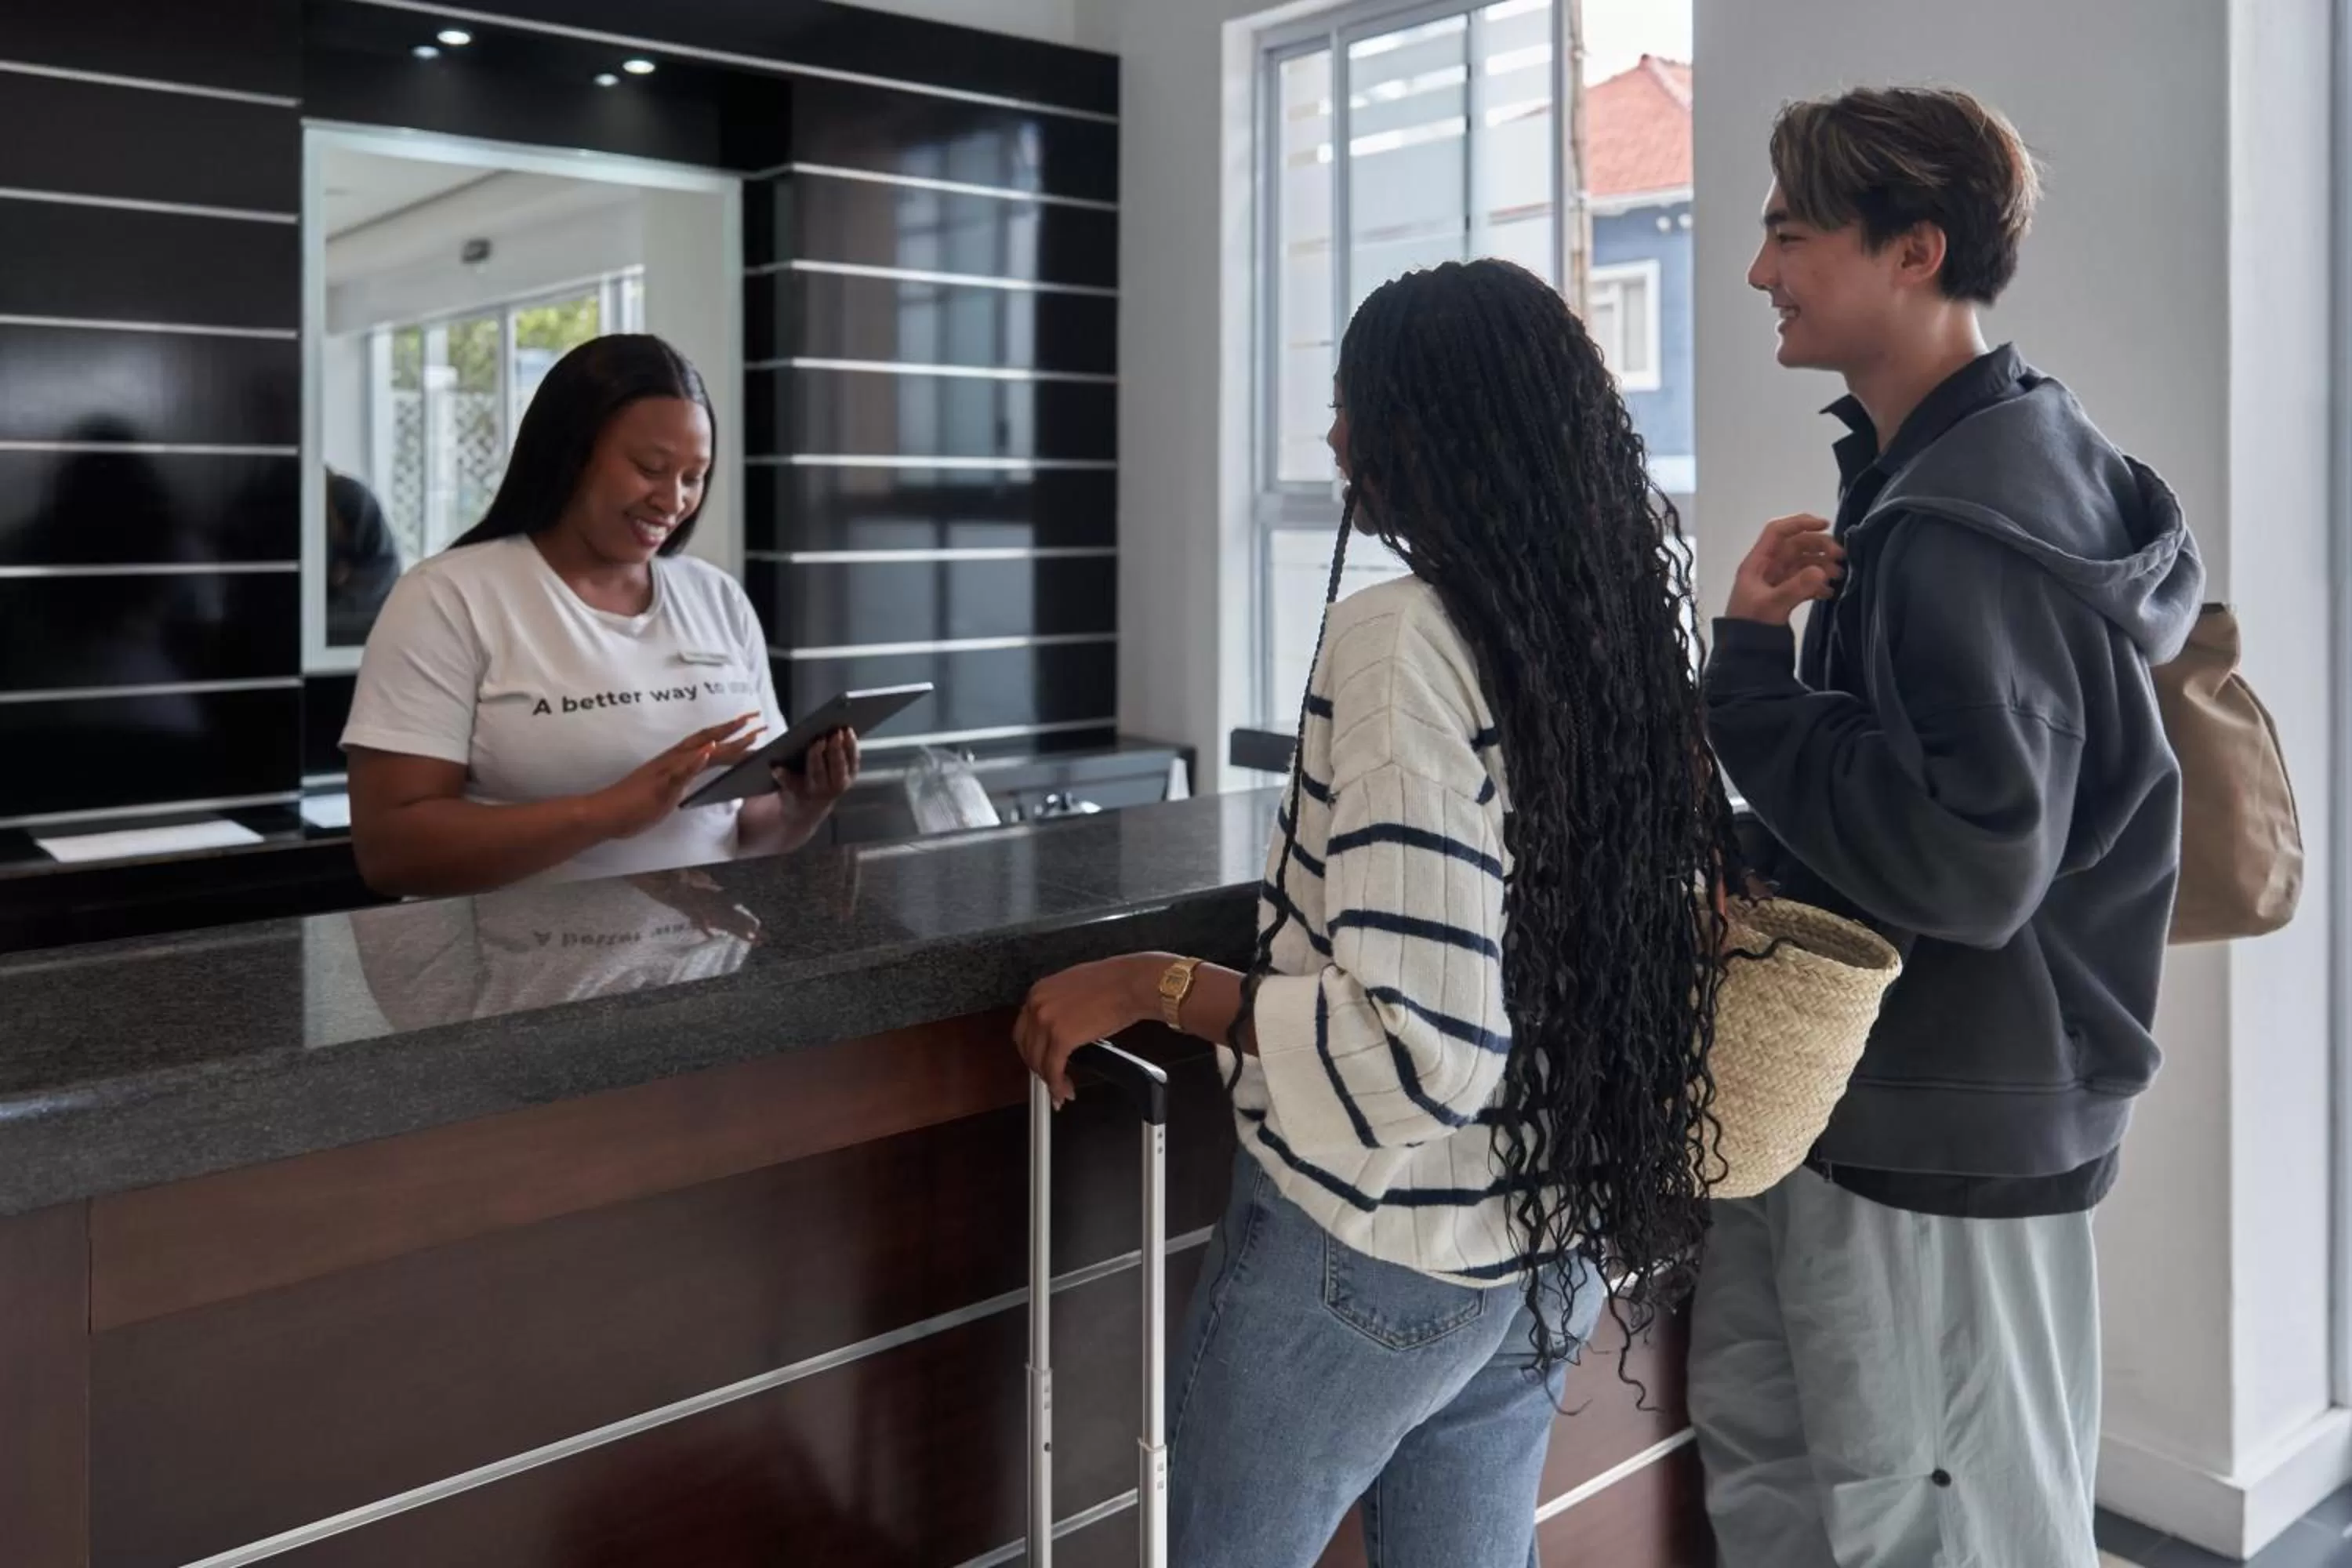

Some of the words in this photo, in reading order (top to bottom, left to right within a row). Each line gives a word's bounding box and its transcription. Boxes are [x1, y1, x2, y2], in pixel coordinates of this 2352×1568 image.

[532, 698, 553, 717] A
[561, 689, 644, 714] better
[649, 684, 698, 702] way
